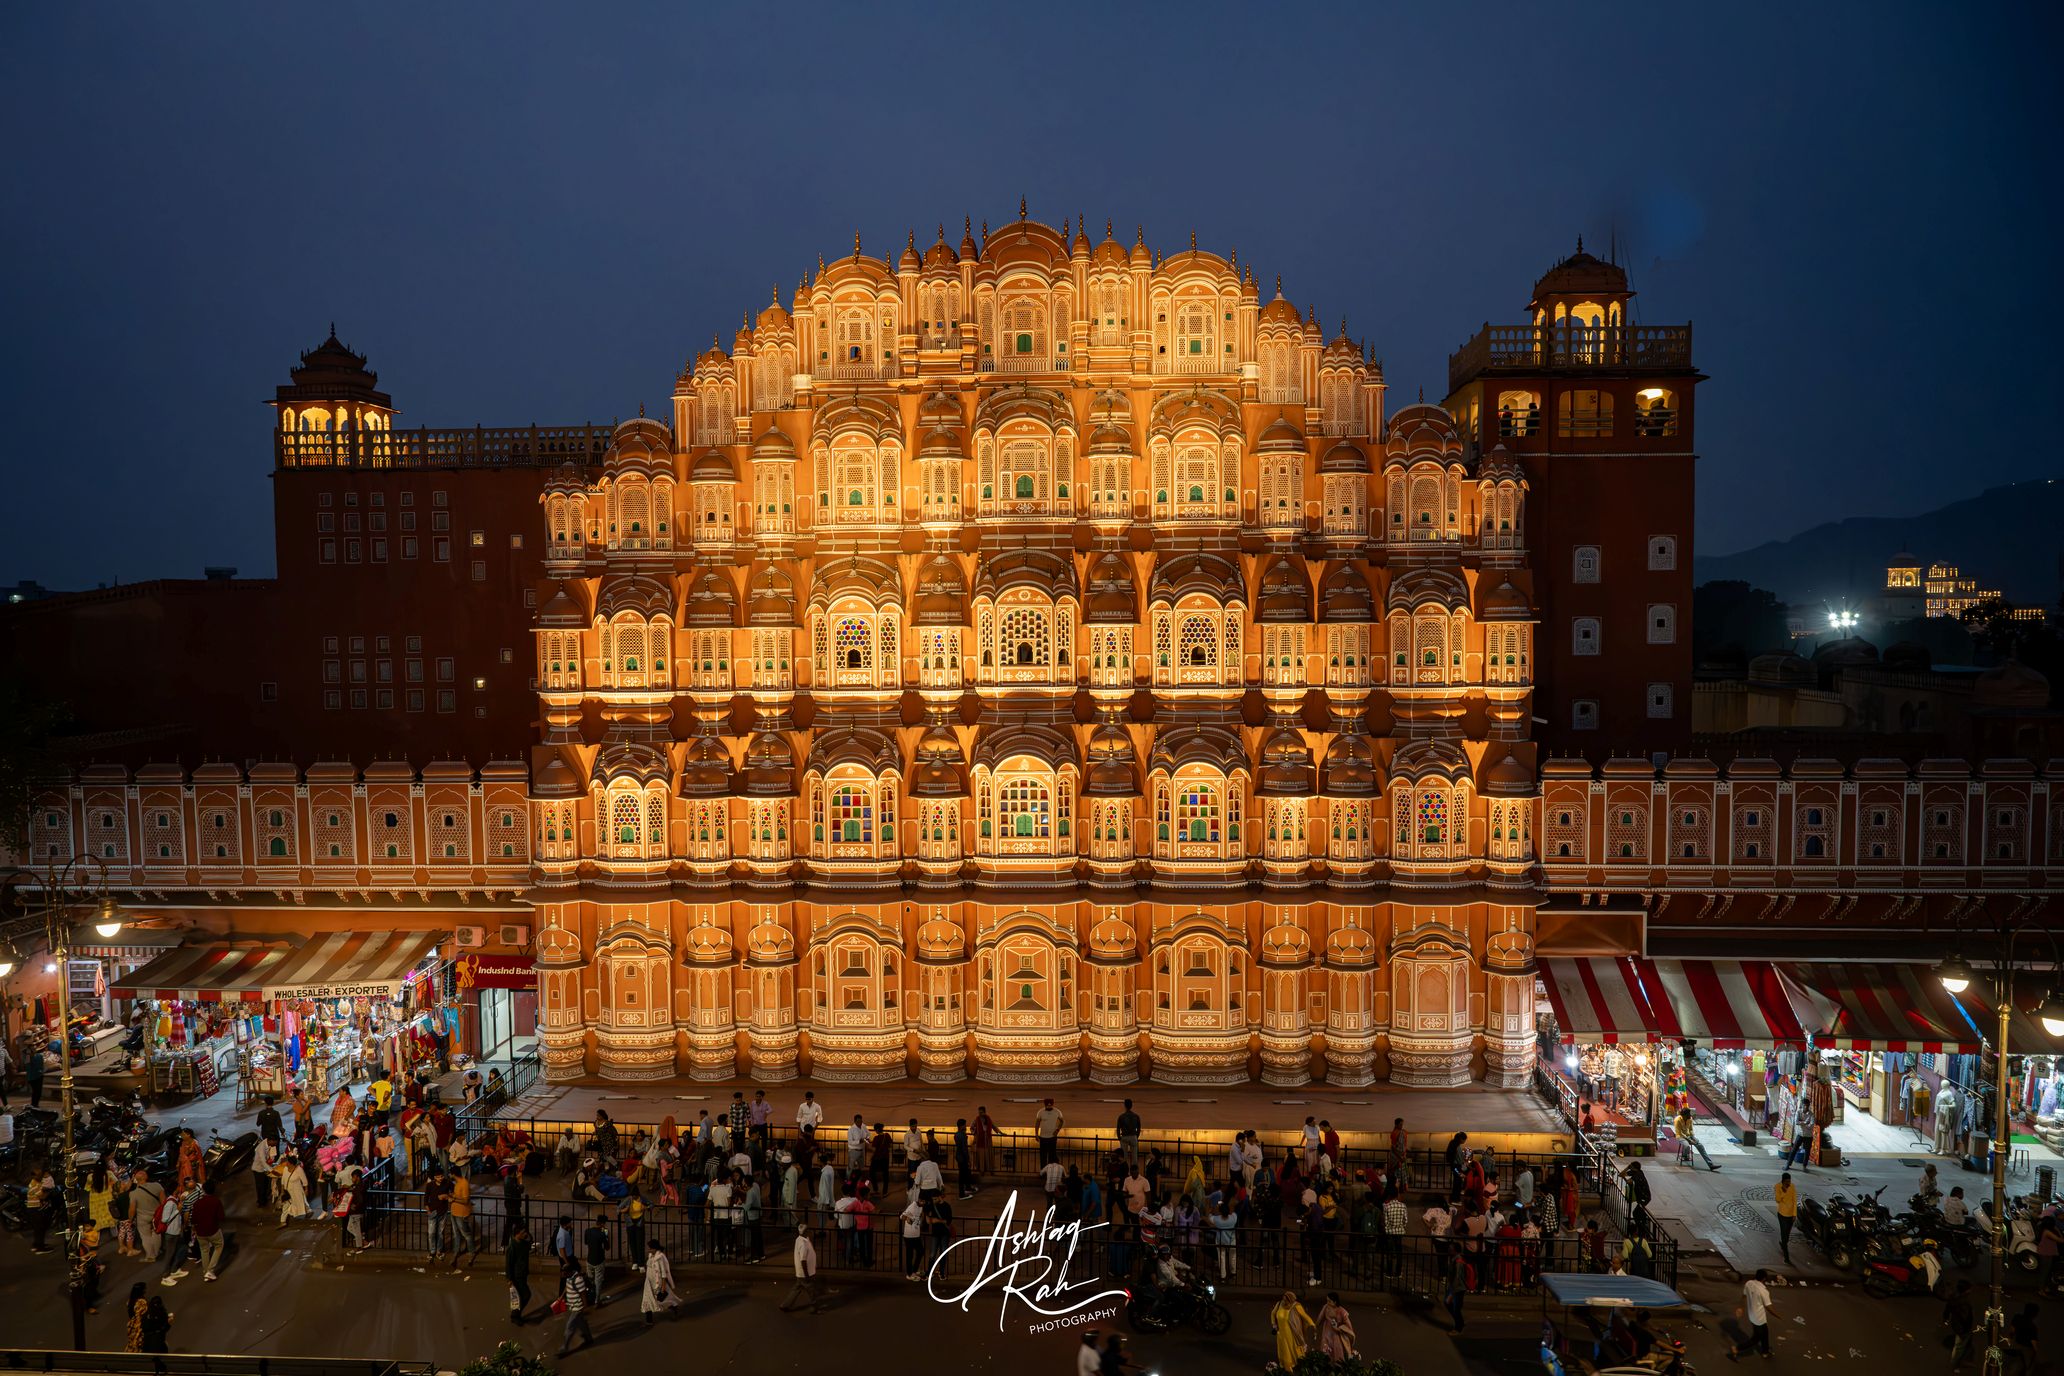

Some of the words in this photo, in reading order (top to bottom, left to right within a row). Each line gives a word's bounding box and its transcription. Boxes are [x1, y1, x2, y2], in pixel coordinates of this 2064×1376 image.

[478, 966, 515, 975] IndusInd
[515, 967, 537, 975] Bank
[274, 987, 330, 999] WHOLESALER
[335, 985, 390, 996] EXPORTER
